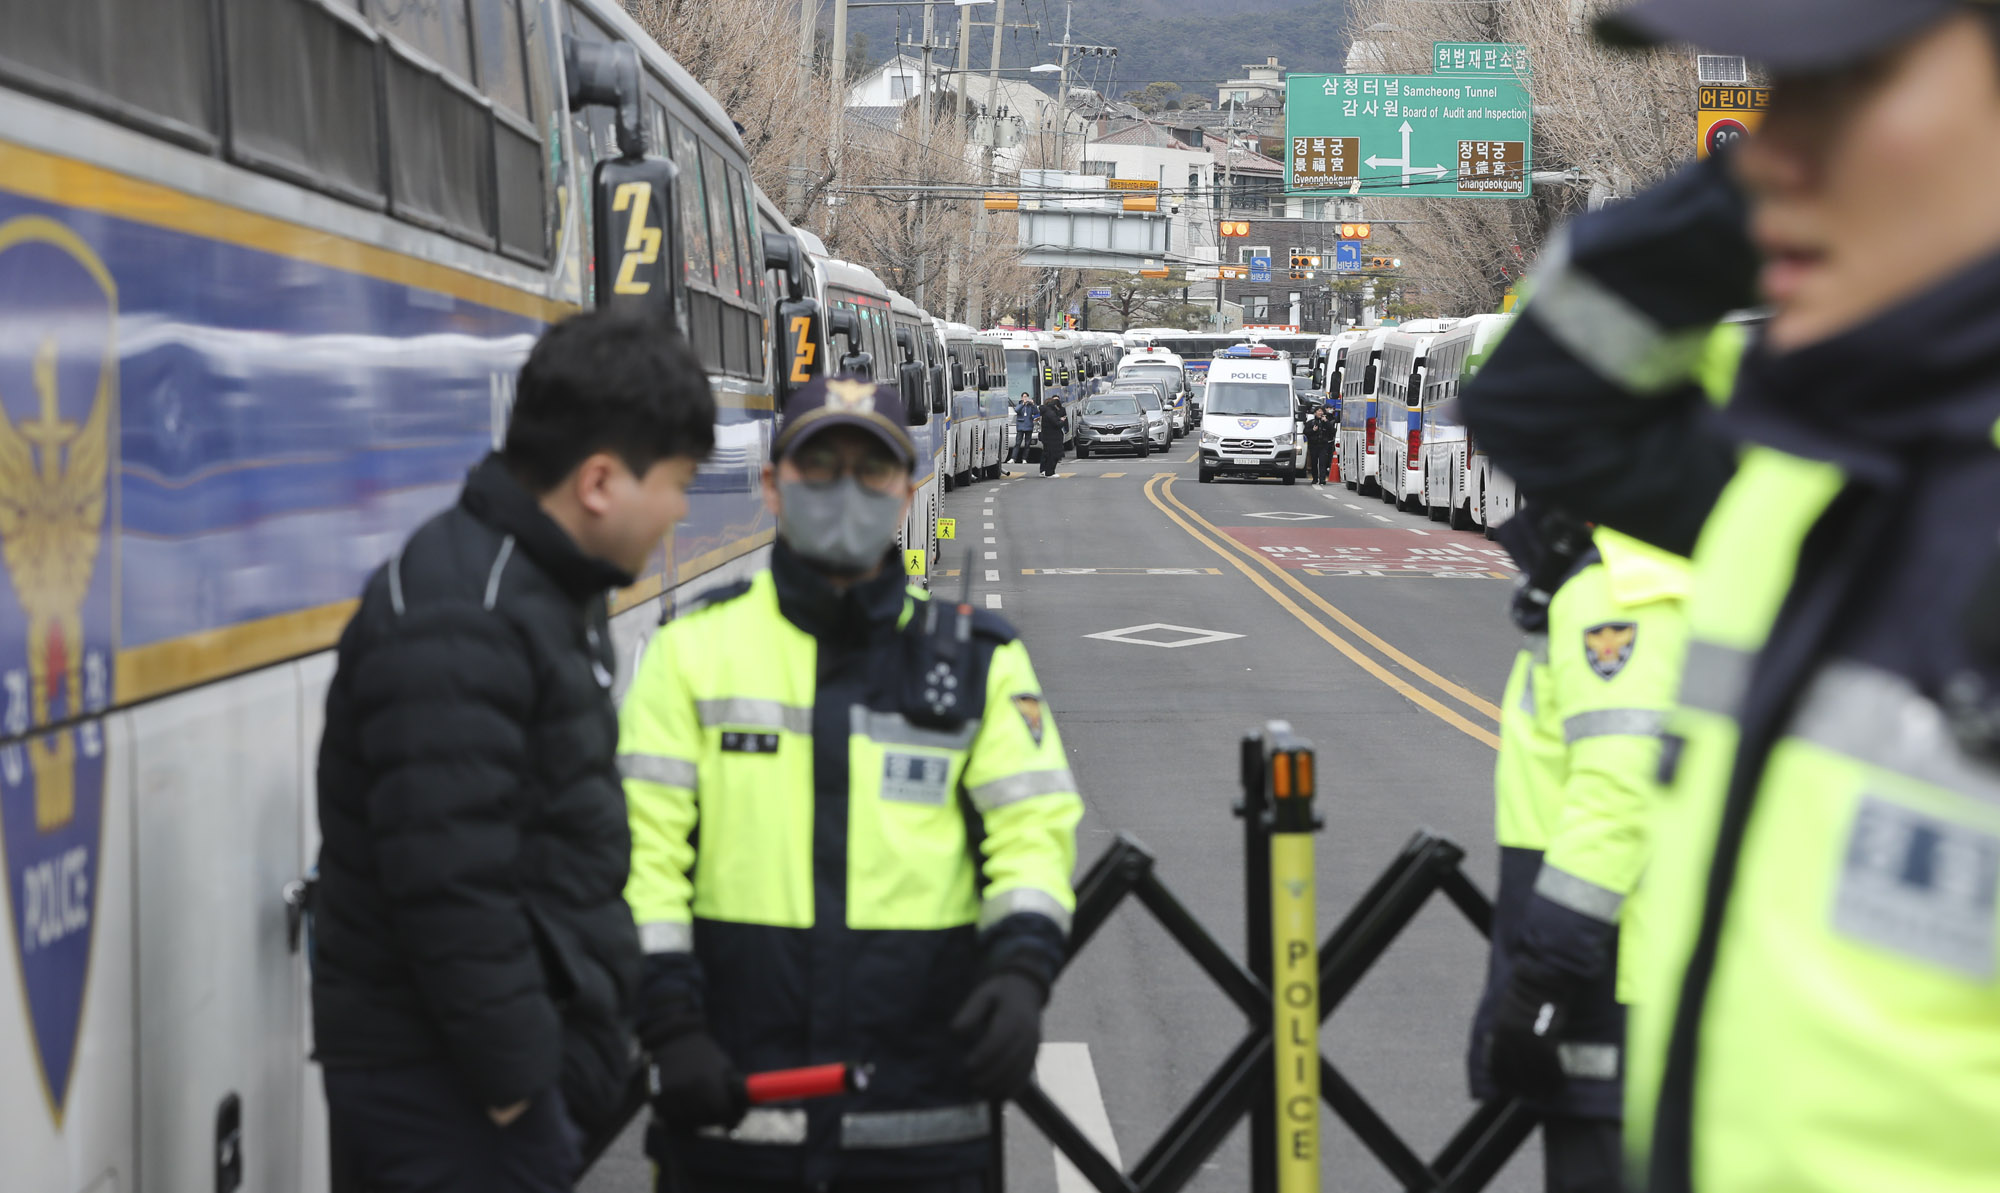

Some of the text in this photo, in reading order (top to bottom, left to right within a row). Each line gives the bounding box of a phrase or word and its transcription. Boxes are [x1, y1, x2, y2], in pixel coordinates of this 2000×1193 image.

[1322, 78, 1399, 96] 삼청터널
[1403, 85, 1497, 99] Samcheong Tunnel
[1342, 99, 1399, 117] 감사원
[1403, 106, 1527, 121] Board of Audit and Inspection
[1294, 138, 1344, 156] 경복궁
[1460, 141, 1505, 159] 창덕궁
[1295, 157, 1344, 172] 景福宮
[1459, 178, 1522, 191] Changdeokgung
[1337, 261, 1360, 271] 비보호
[1231, 372, 1268, 380] POLICE
[24, 845, 88, 953] POLICE
[1285, 940, 1315, 1162] POLICE
